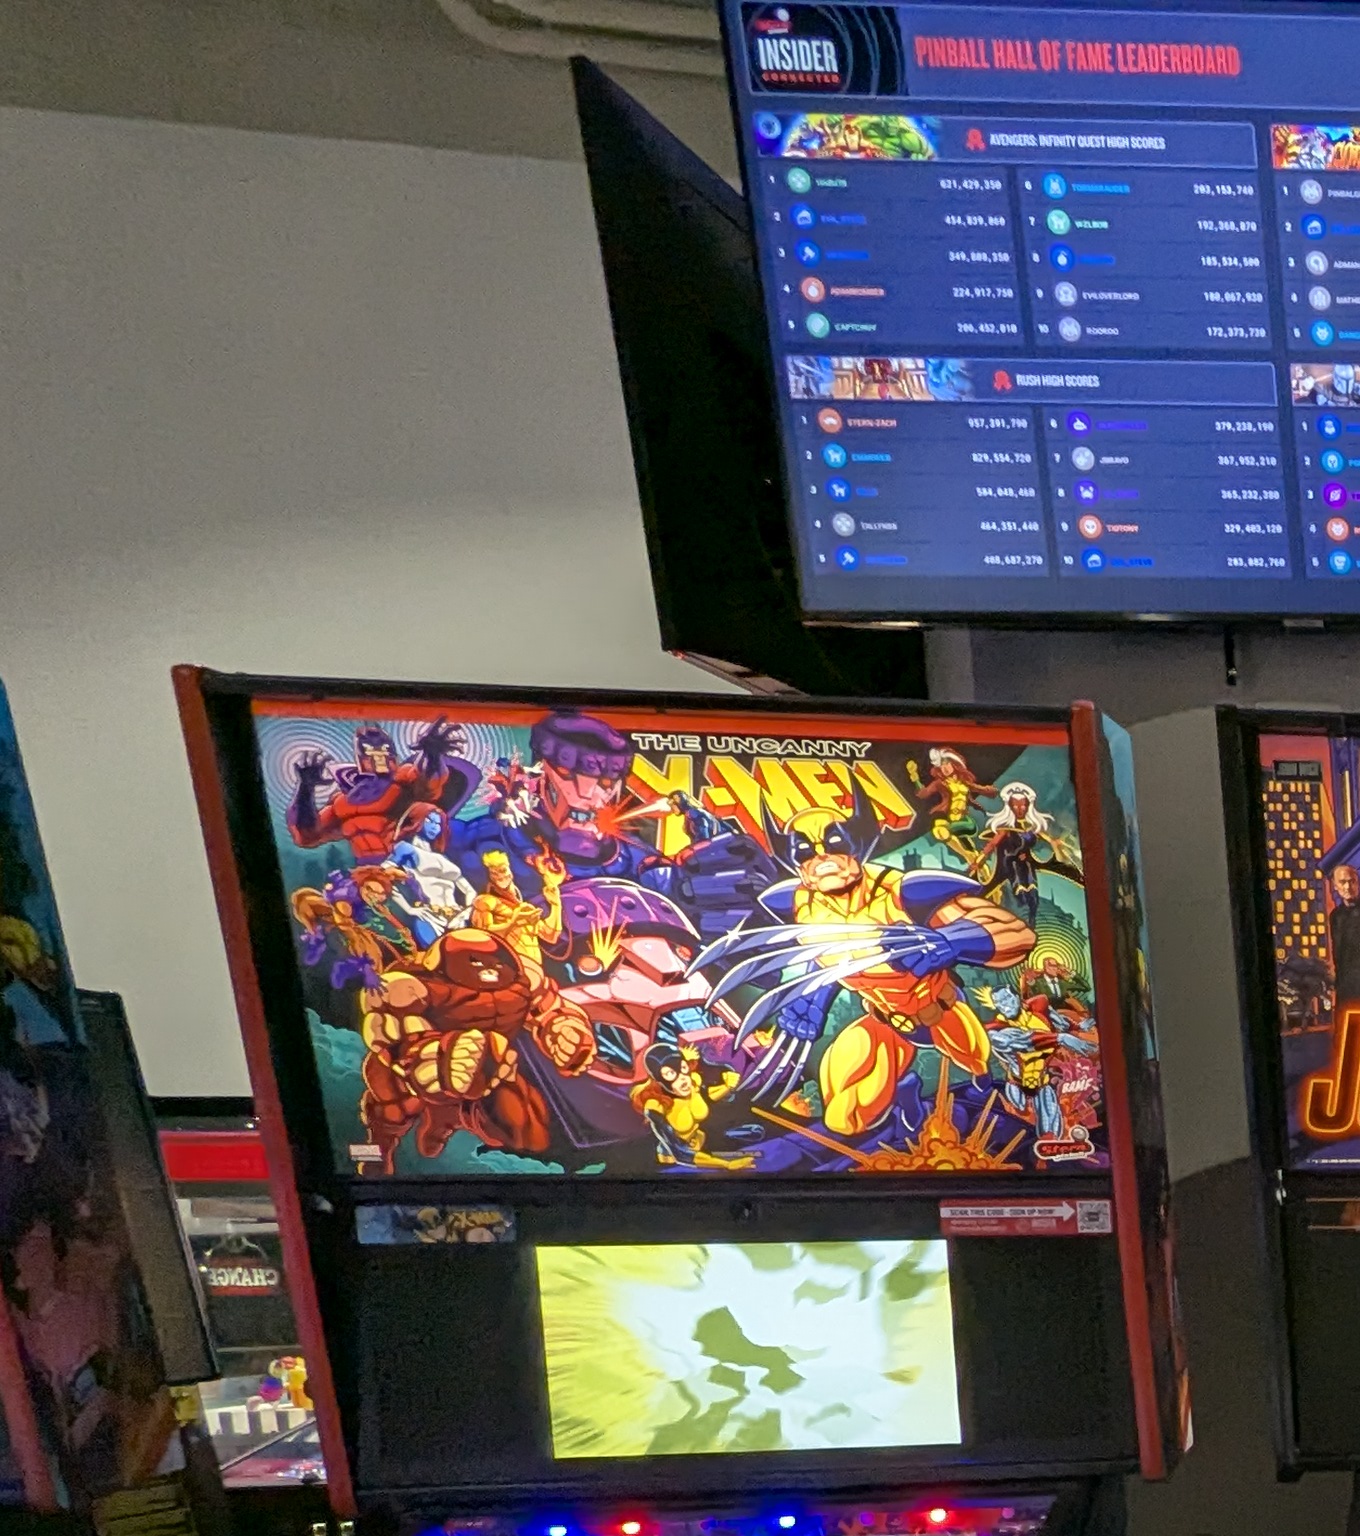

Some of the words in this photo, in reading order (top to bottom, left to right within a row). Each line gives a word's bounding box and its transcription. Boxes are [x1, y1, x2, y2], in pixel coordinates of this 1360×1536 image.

[757, 36, 838, 73] INSIDER
[914, 35, 990, 70] PINBALL
[993, 38, 1037, 71] HALL
[1039, 39, 1062, 72] OF
[1066, 41, 1114, 73] FAME
[1117, 42, 1242, 77] LEADERBOARD
[990, 133, 1037, 148] AVENGERS:
[1039, 134, 1076, 149] INFINITY
[1077, 135, 1105, 149] QUEST
[1107, 135, 1130, 150] HIGH
[1131, 136, 1166, 151] SCORES
[1038, 324, 1049, 333] 10
[1016, 374, 1040, 387] RUSH
[1042, 375, 1063, 387] HIGH
[1065, 375, 1100, 388] SCORES
[1064, 555, 1073, 565] 10
[632, 733, 701, 751] THE
[707, 736, 872, 757] UNCANNY
[626, 753, 916, 857] X-MEN
[1062, 1077, 1092, 1094] BAMF
